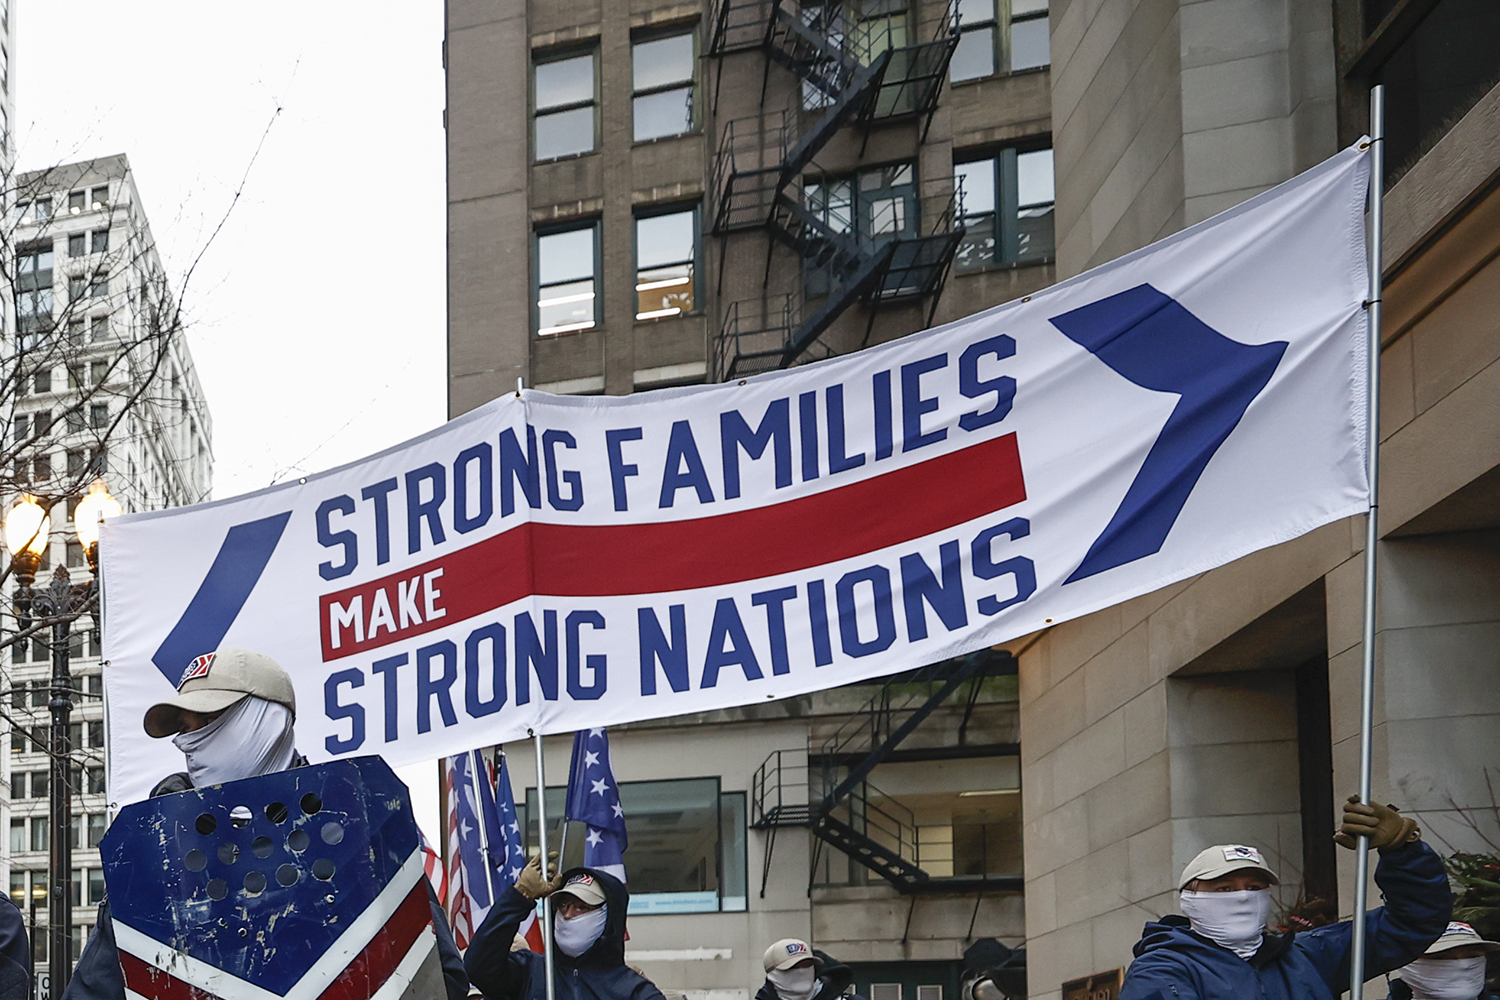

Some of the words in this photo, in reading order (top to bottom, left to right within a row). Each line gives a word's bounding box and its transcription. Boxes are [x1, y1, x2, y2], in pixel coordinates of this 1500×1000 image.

[315, 423, 585, 582] STRONG
[606, 333, 1018, 512] FAMILIES
[324, 608, 608, 756] STRONG
[637, 516, 1039, 698] NATIONS
[329, 566, 448, 650] MAKE
